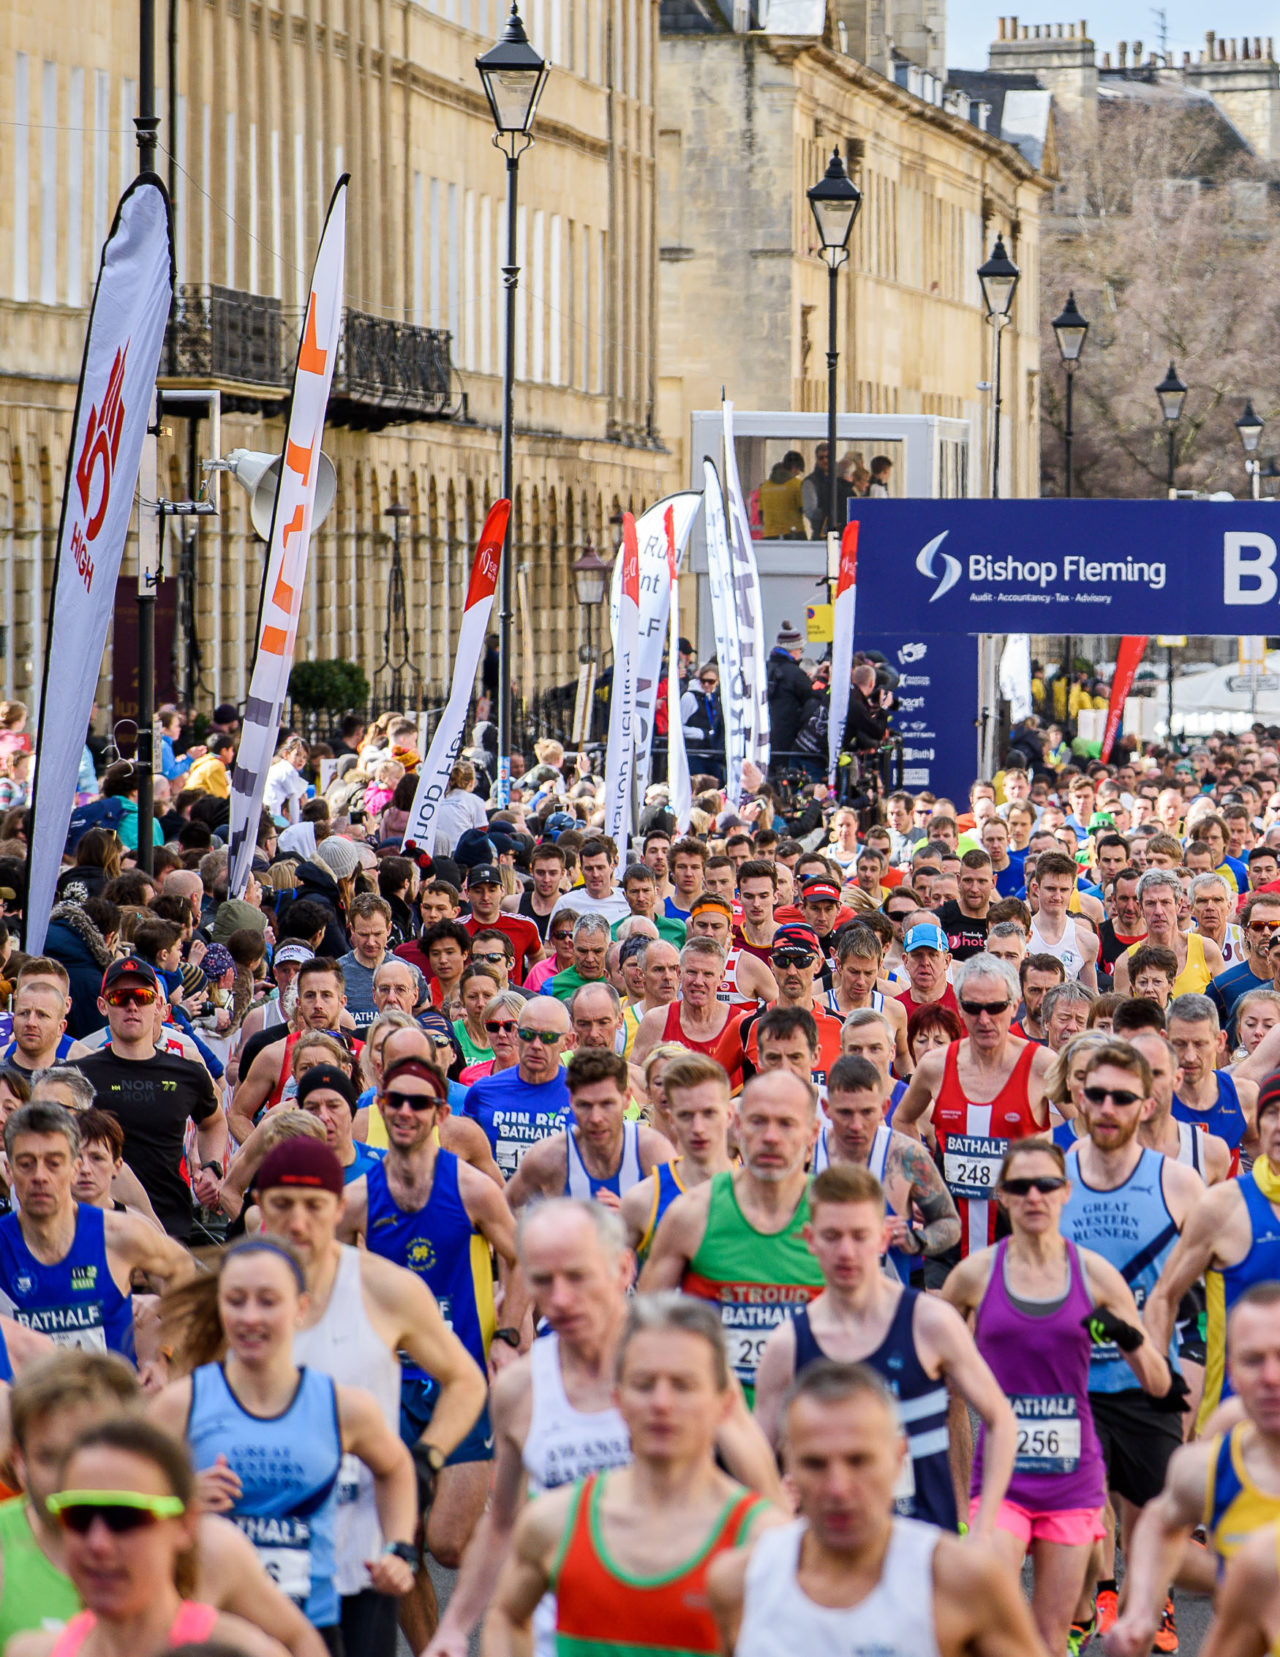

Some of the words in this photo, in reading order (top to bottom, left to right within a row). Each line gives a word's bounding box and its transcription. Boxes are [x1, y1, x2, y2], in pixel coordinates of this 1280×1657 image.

[70, 521, 94, 594] HIGH
[969, 555, 1058, 588] Bishop
[1064, 556, 1166, 589] Fleming
[997, 593, 1050, 604] Accountancy
[1075, 593, 1112, 604] Advisory
[947, 1136, 1008, 1156] BATHALF
[957, 1164, 991, 1186] 248
[1082, 1201, 1130, 1215] GREAT
[1072, 1212, 1140, 1229] WESTERN
[1072, 1227, 1140, 1242] RUNNERS
[719, 1286, 809, 1303] STROUD
[722, 1306, 803, 1326] BATHAL
[1011, 1397, 1076, 1417] ATHALF
[1017, 1431, 1060, 1455] 256
